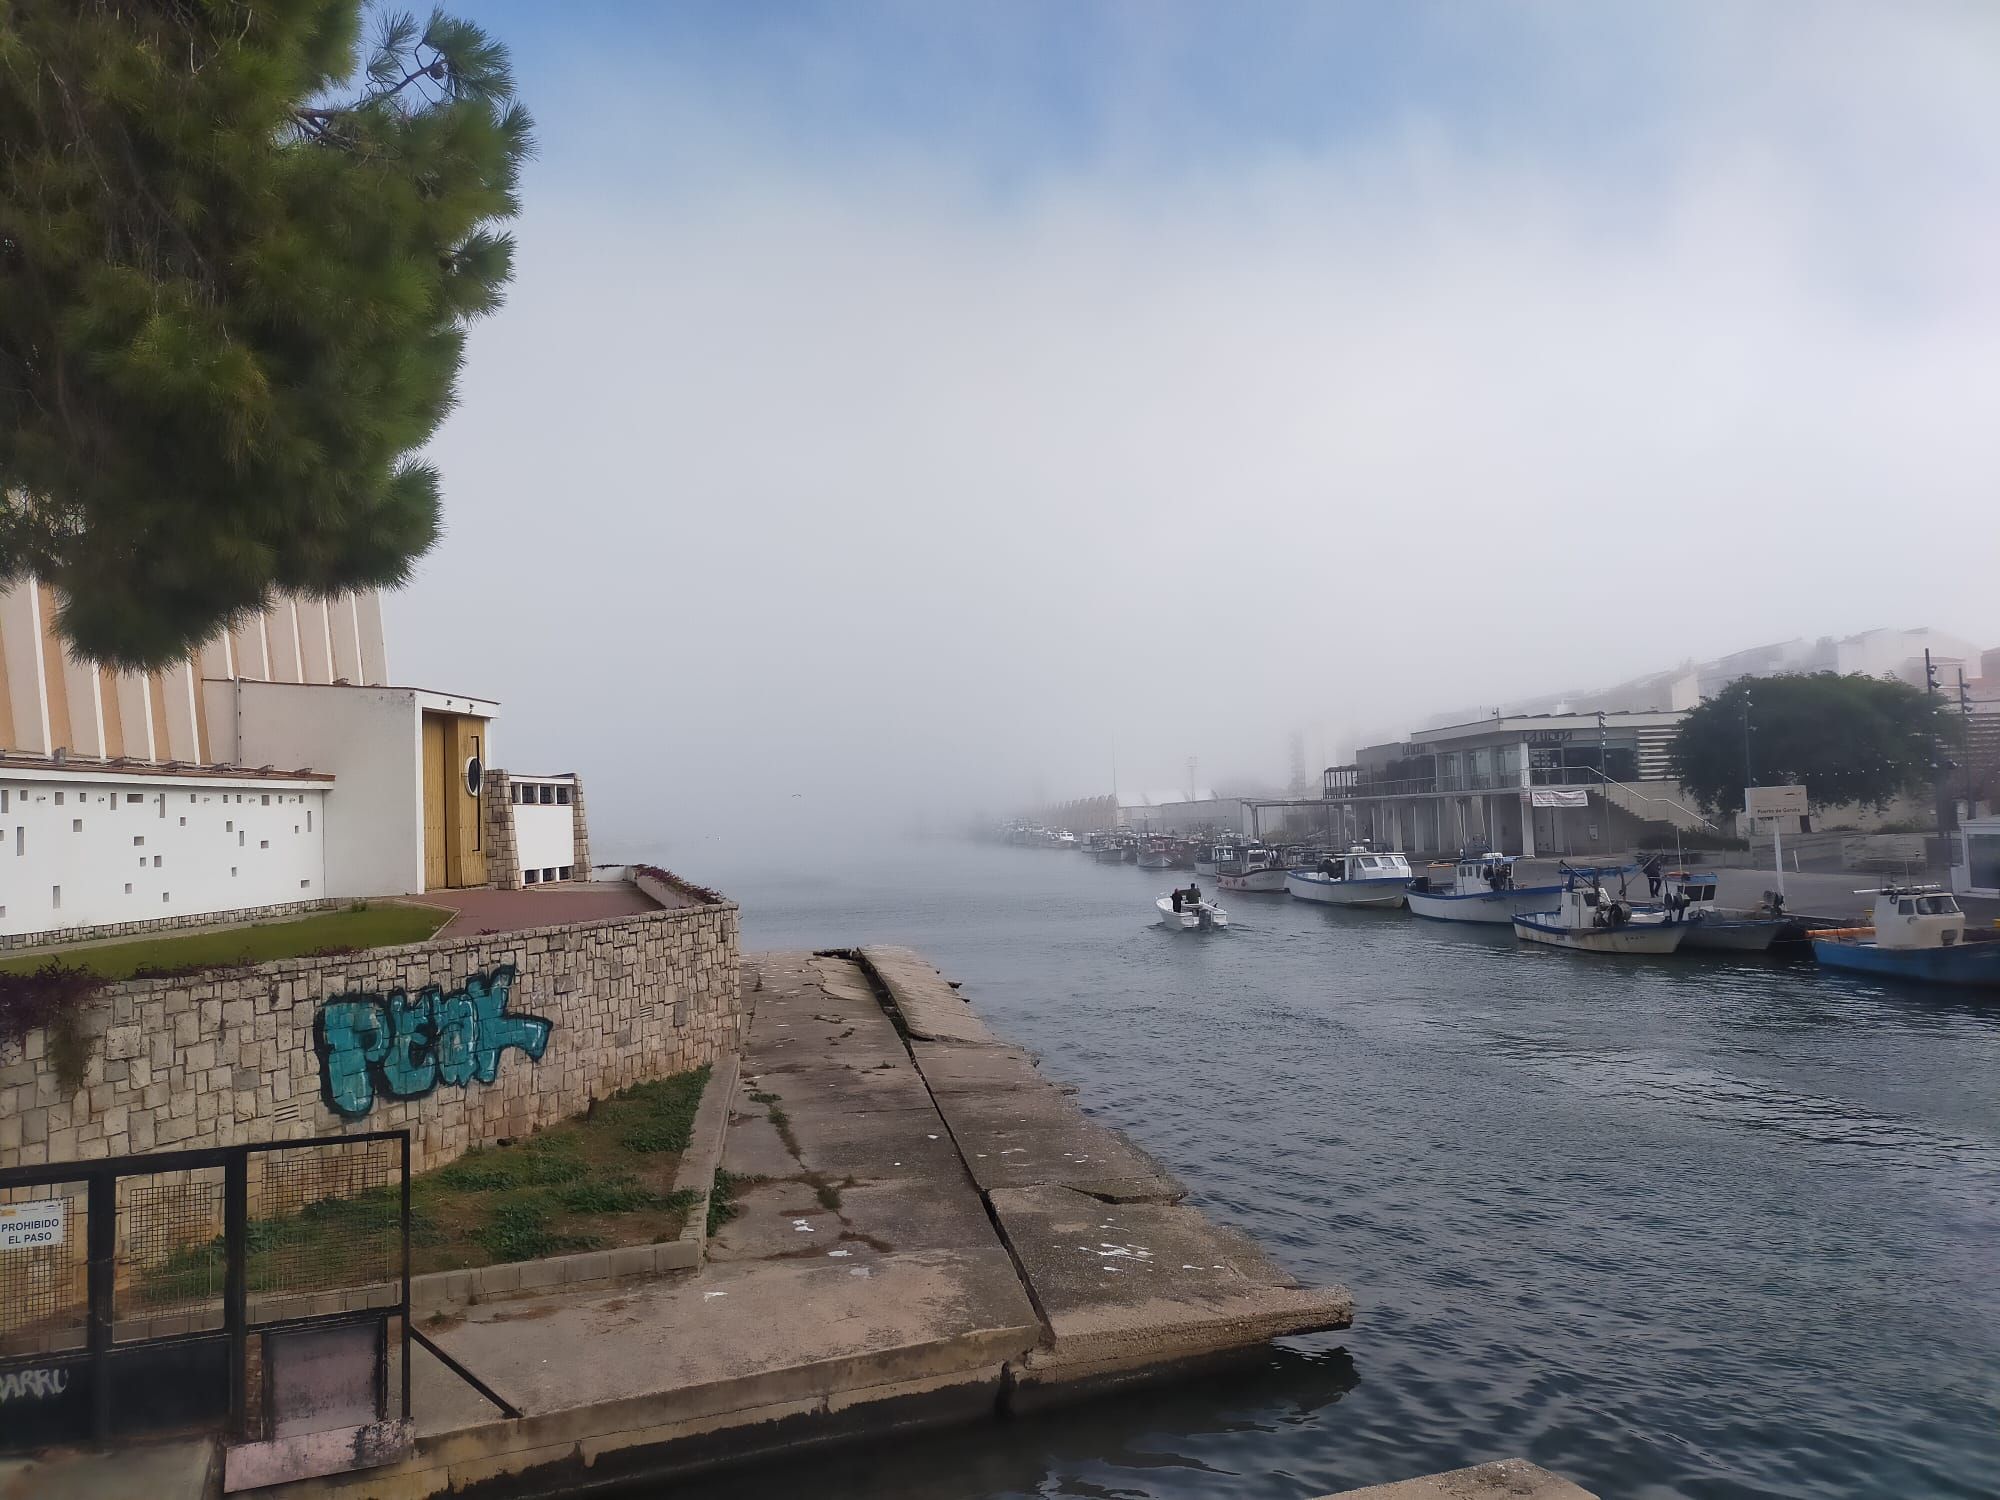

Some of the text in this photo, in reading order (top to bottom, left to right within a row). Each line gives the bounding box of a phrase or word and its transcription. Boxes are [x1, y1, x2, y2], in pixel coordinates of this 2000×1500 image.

[1, 1218, 59, 1232] PROHIBIDO
[8, 1232, 52, 1245] EL PASO
